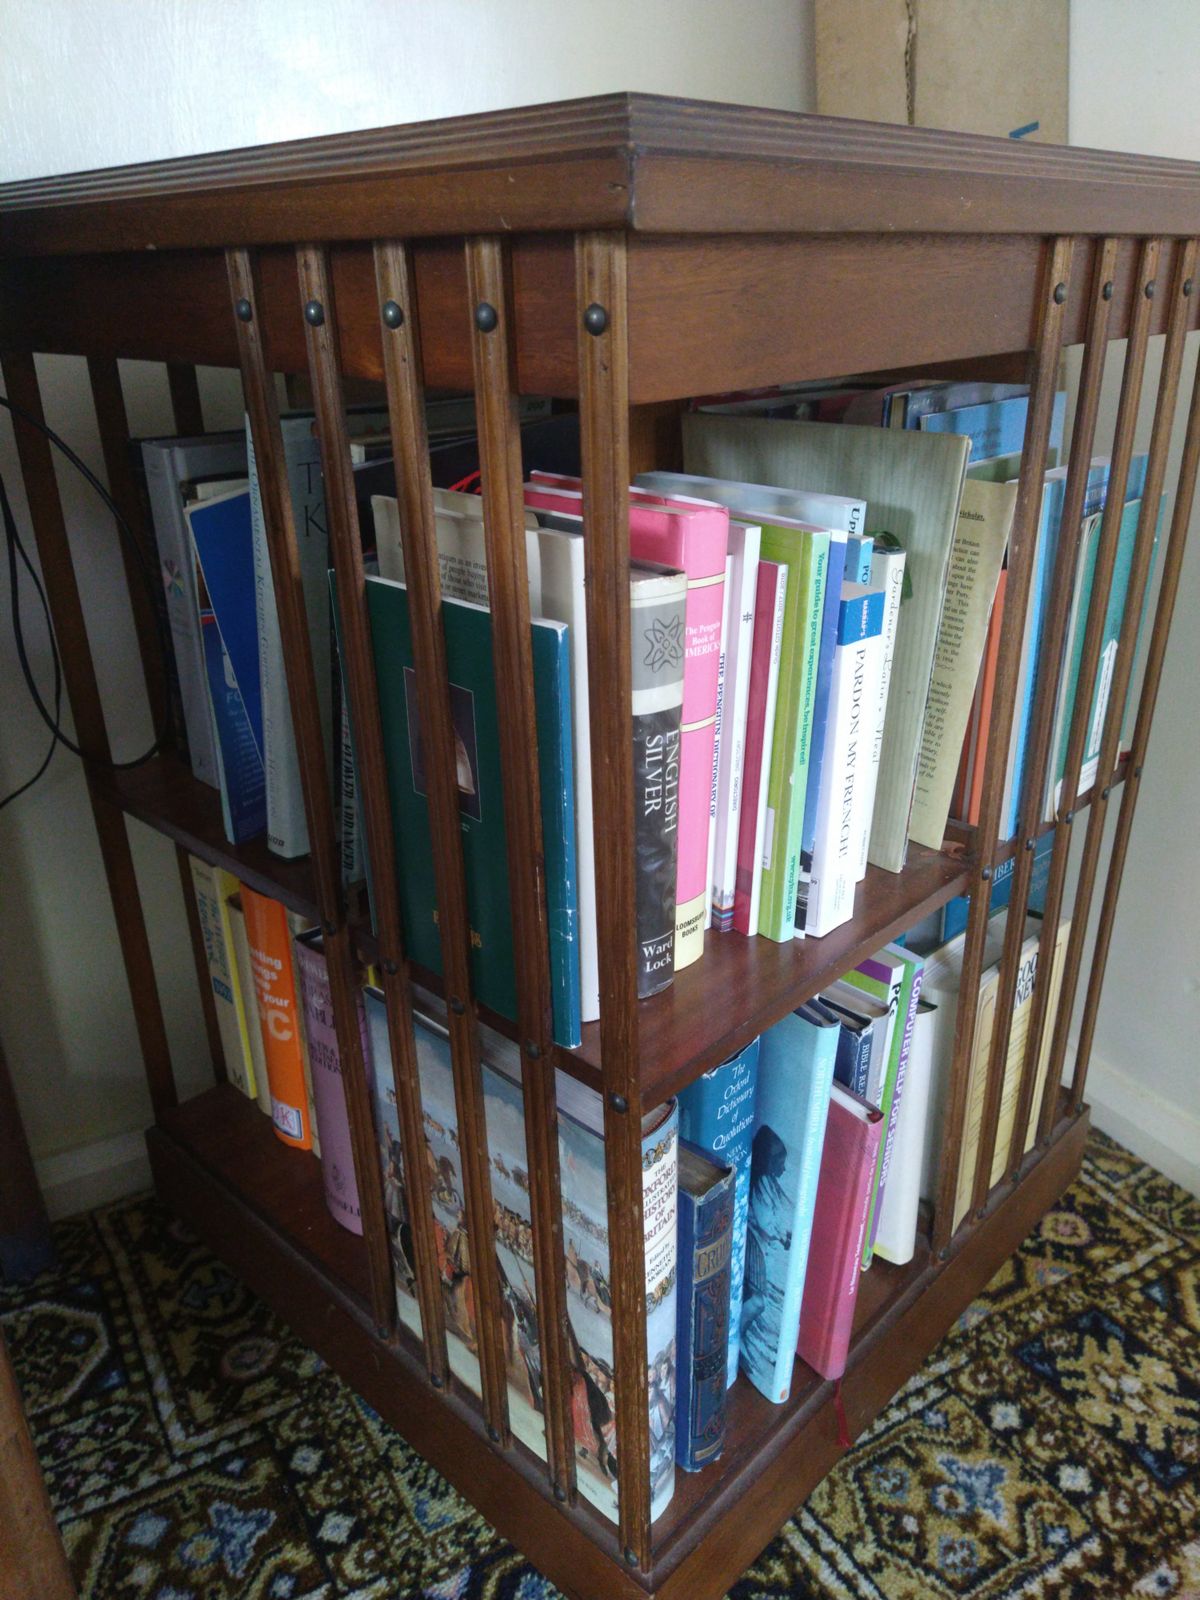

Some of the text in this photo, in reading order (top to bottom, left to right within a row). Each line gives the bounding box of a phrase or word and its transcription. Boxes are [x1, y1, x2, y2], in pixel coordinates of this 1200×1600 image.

[815, 551, 825, 577] Your
[812, 577, 822, 608] guide
[812, 608, 819, 620] to
[692, 636, 707, 646] Book
[808, 619, 818, 647] great
[717, 652, 725, 678] THE
[850, 647, 866, 735] PARDON
[714, 681, 724, 736] PENGUIN
[844, 740, 858, 769] MY
[644, 735, 663, 816] SILVER
[664, 729, 680, 833] ENGLISH
[710, 738, 720, 801] DICTIONARY
[838, 772, 855, 858] FRENCH!
[675, 911, 705, 931] LOOMSBURY
[682, 924, 699, 938] BOOKS
[643, 936, 673, 958] Ward
[646, 953, 672, 973] Lock
[731, 1063, 746, 1080] The
[858, 1043, 870, 1073] BIBLE
[724, 1070, 751, 1100] Oxford
[879, 975, 922, 1188] COMPUTER HELP FOR SENIORS
[717, 1086, 755, 1120] Dictionary
[731, 1109, 739, 1123] of
[712, 1111, 755, 1151] Quotations
[654, 1162, 668, 1178] THE
[654, 1208, 666, 1222] OF
